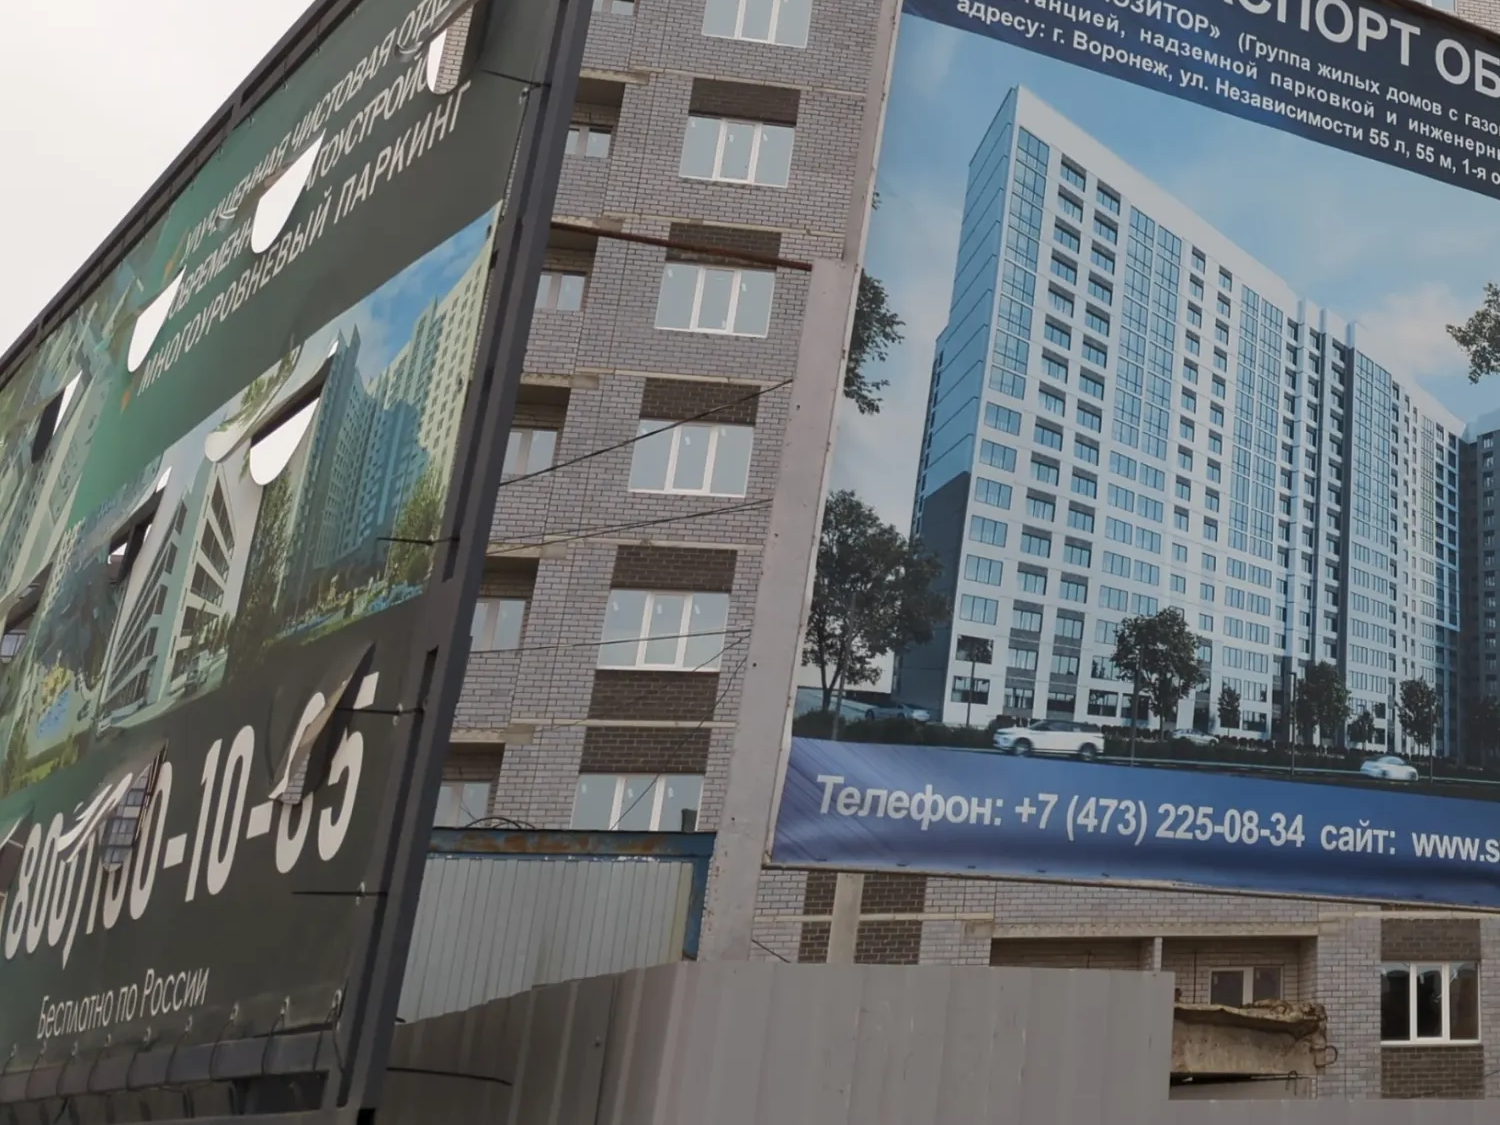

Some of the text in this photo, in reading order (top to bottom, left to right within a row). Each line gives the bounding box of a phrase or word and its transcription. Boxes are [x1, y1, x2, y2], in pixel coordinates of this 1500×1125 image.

[291, 27, 397, 151] ЧИСТОВАЯ
[1052, 26, 1065, 44] г.
[1072, 30, 1173, 82] Воронеж,
[1180, 67, 1209, 98] ул.
[1215, 79, 1363, 140] Независимости
[1369, 128, 1389, 149] 55
[1394, 137, 1411, 159] л,
[1415, 143, 1434, 163] 55
[1439, 155, 1456, 174] м,
[1462, 158, 1486, 181] 1-я
[1140, 29, 1258, 81] надземной
[1270, 71, 1375, 119] парковкой
[1386, 110, 1397, 126] и
[1238, 32, 1311, 75] (Группа
[1317, 62, 1379, 95] жилых
[1386, 85, 1442, 117] домов
[1449, 107, 1458, 121] с
[137, 80, 471, 396] МНОГОУРОВНЕВЫЙ ПАРКИНГ
[816, 775, 1003, 831] Телефон:
[1015, 793, 1059, 829] +7
[1066, 795, 1147, 845] (473)
[1155, 803, 1305, 848] 225-08-34
[1320, 819, 1396, 855] сайт:
[37, 967, 210, 1040] Бесплатно по России
